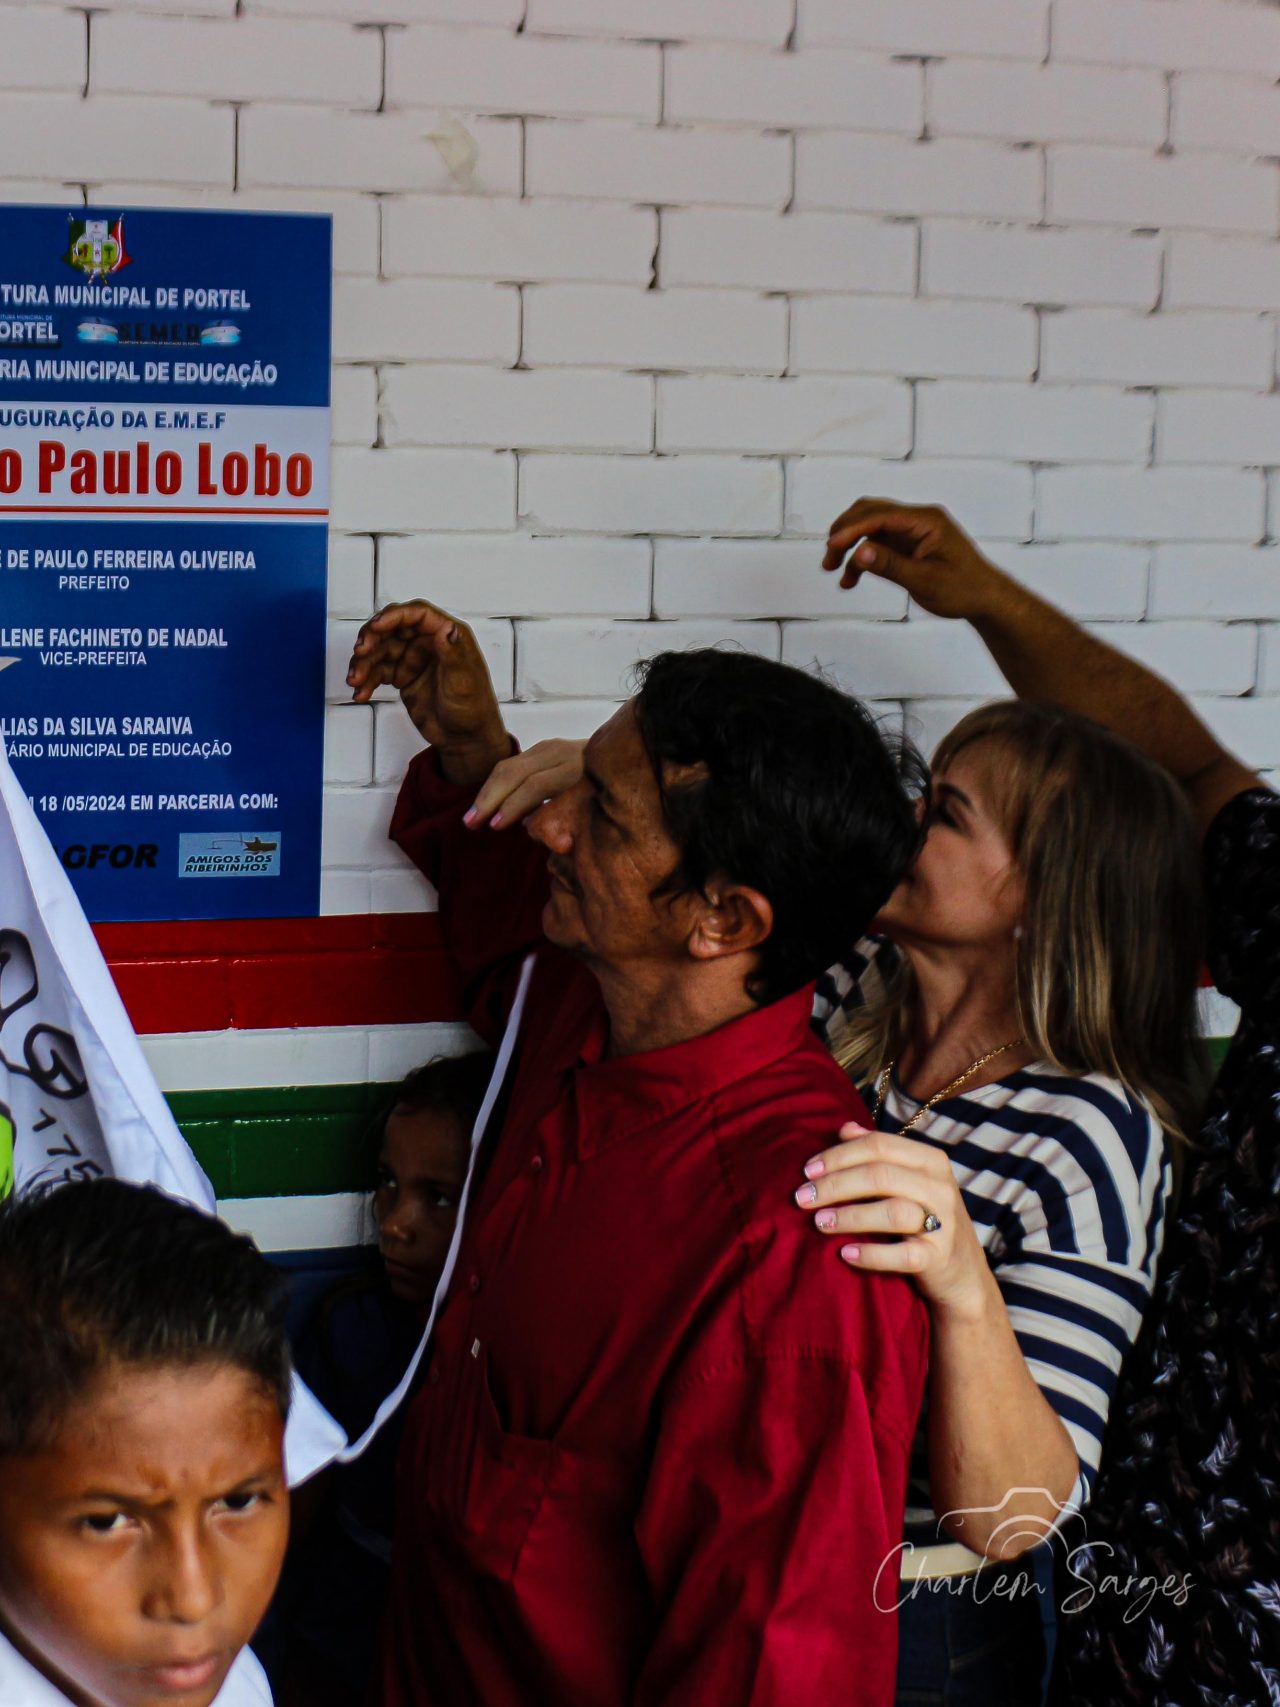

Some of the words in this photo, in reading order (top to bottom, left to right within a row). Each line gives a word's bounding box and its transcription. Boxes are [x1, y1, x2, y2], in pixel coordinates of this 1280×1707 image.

[55, 286, 150, 307] MUNICIPAL
[157, 287, 178, 308] DE
[183, 288, 250, 309] PORTEL
[35, 360, 140, 381] MUNICIPAL
[145, 362, 169, 381] DE
[174, 360, 277, 386] EDUCAÇÃO
[122, 410, 148, 428] DA
[155, 411, 226, 429] E.M.E.F
[38, 440, 182, 495] Paulo
[197, 442, 312, 496] Lobo
[7, 550, 30, 569] DE
[34, 550, 88, 569] PAULO
[93, 550, 175, 569] FERREIRA
[179, 550, 256, 569] OLIVEIRA
[59, 575, 129, 590] PREFEITO
[49, 628, 143, 647] FACHINETO
[148, 628, 170, 647] DE
[174, 628, 227, 647] NADAL
[40, 651, 146, 665] VICE-PREFEITA
[0, 718, 38, 736] LIAS
[43, 717, 66, 736] DA
[70, 717, 117, 736] SILVA
[122, 716, 193, 735] SARAIVA
[48, 743, 124, 757] MUNICIPAL
[129, 743, 148, 757] DE
[152, 740, 232, 759] EDUCAÇÃO
[39, 796, 58, 811] 18
[62, 794, 126, 811] /05/2024
[131, 794, 154, 809] EM
[158, 794, 235, 809] PARCERIA
[239, 793, 279, 809] COM:
[54, 843, 158, 870] GFOR
[187, 855, 240, 864] AMIGOS
[244, 854, 272, 863] DOS
[185, 863, 268, 873] RIBEIRINHOS
